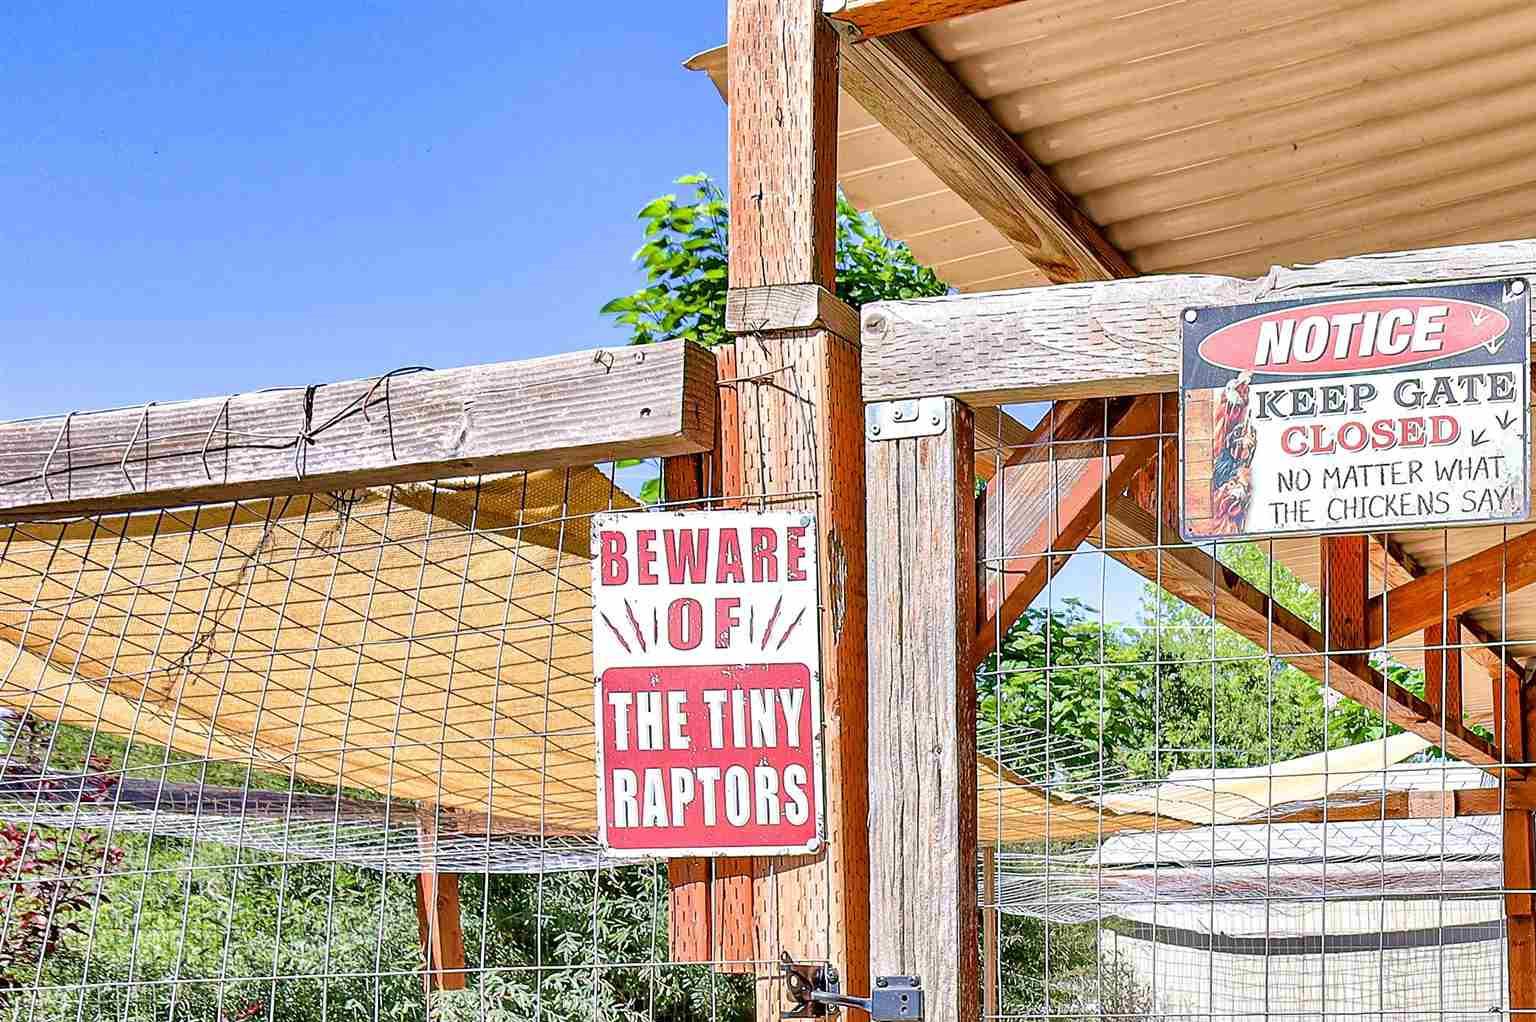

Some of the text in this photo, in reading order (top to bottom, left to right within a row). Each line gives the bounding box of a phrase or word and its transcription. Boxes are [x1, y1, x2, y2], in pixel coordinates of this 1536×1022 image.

[1254, 305, 1449, 367] NOTICE
[1256, 371, 1517, 419] KEEP GATE
[1280, 415, 1463, 457] CLOSED
[1277, 455, 1505, 493] NO MATTER WHAT
[1269, 486, 1521, 527] THE CHICKENS SAY!
[600, 527, 808, 586] BEWARE
[667, 597, 742, 651] OF
[608, 687, 805, 752] THE TINY
[612, 763, 809, 829] RAPTORS
